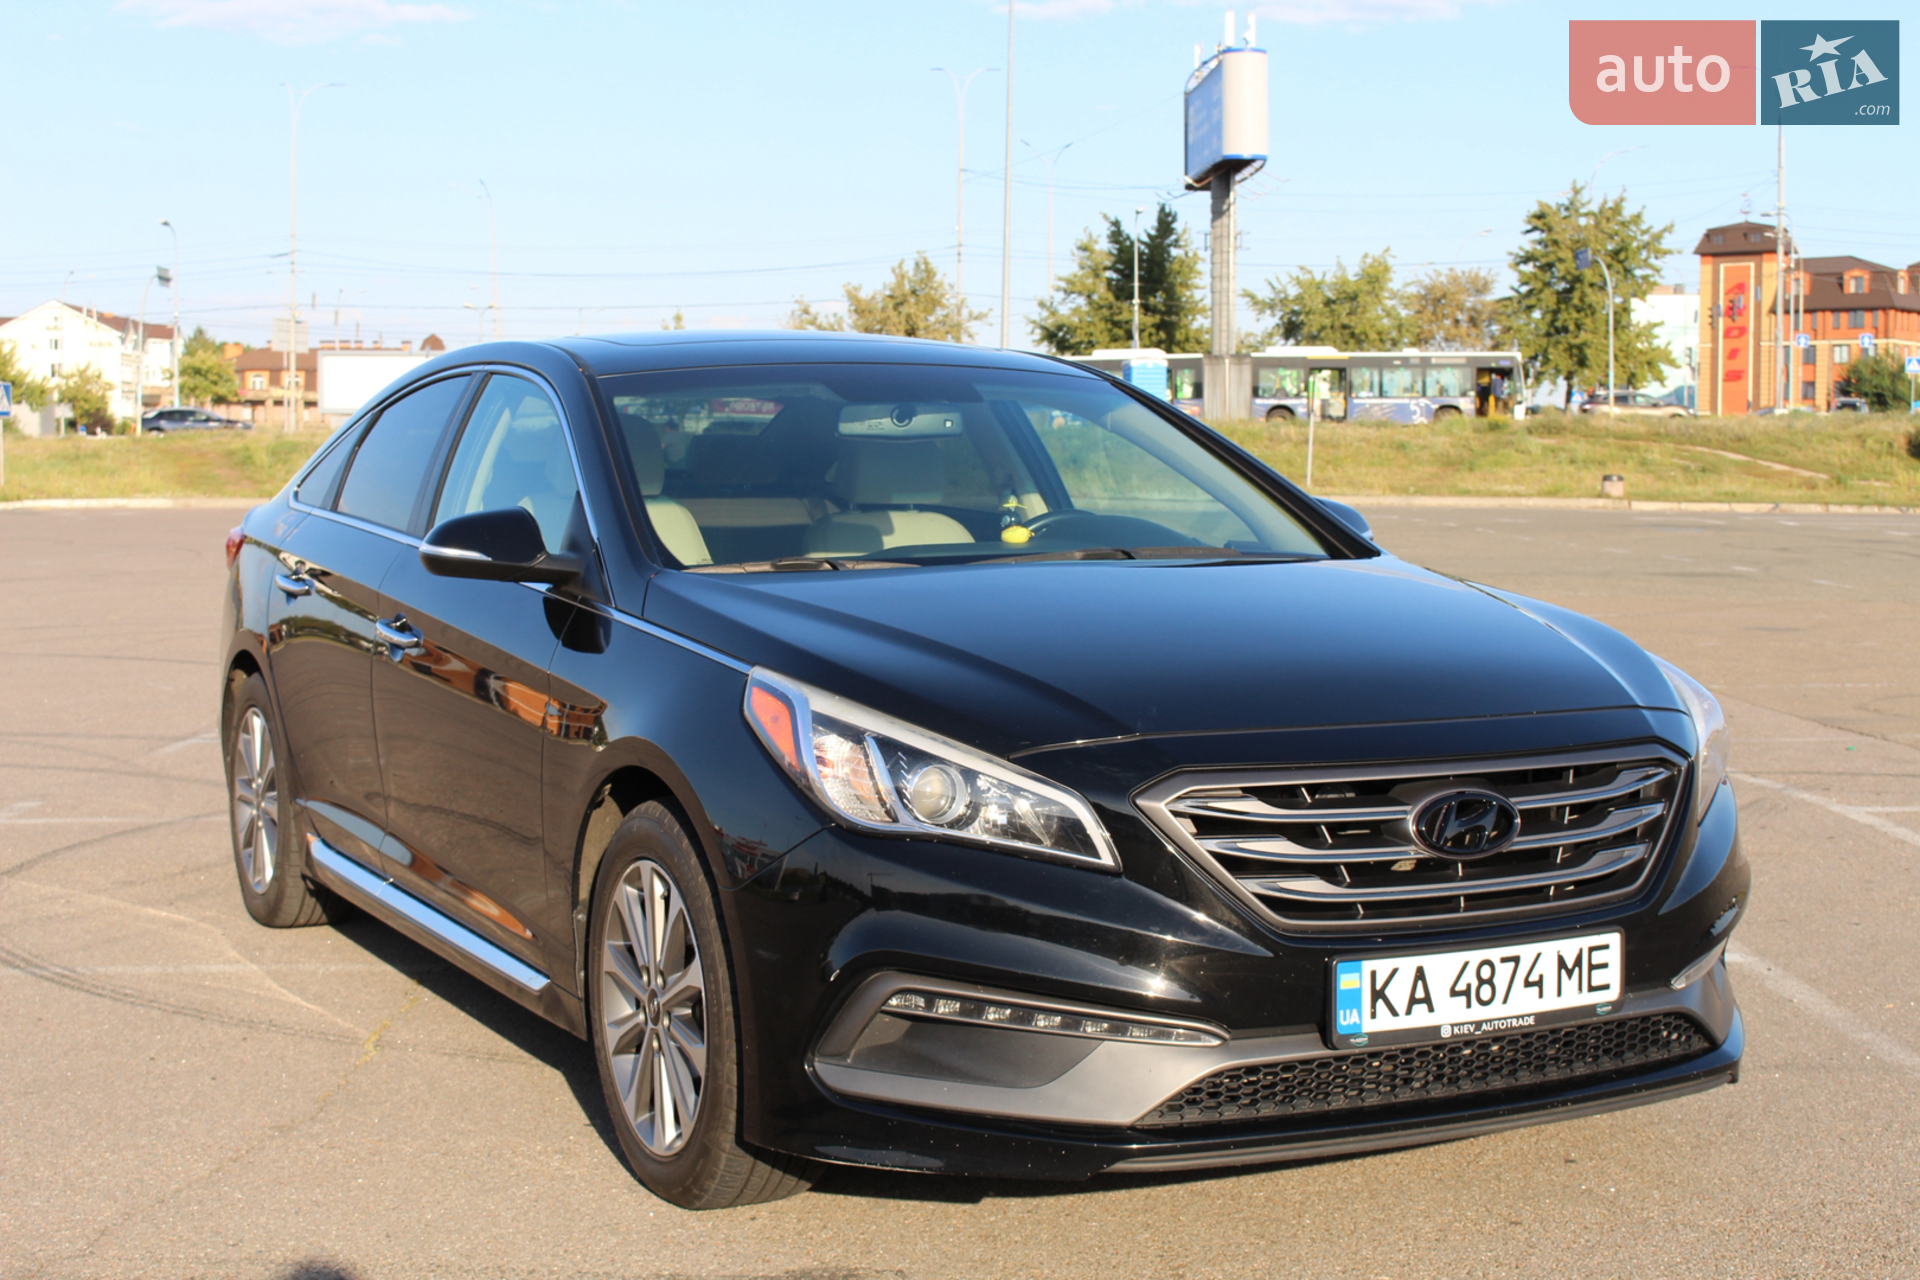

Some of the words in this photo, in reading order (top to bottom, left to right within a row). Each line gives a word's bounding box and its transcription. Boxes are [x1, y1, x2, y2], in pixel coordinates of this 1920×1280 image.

[1369, 965, 1435, 1020] KA
[1449, 951, 1544, 1009] 4874
[1557, 943, 1611, 998] ME
[1339, 1008, 1361, 1026] UA
[1452, 1015, 1536, 1036] KIEV_AUTOTRADE
